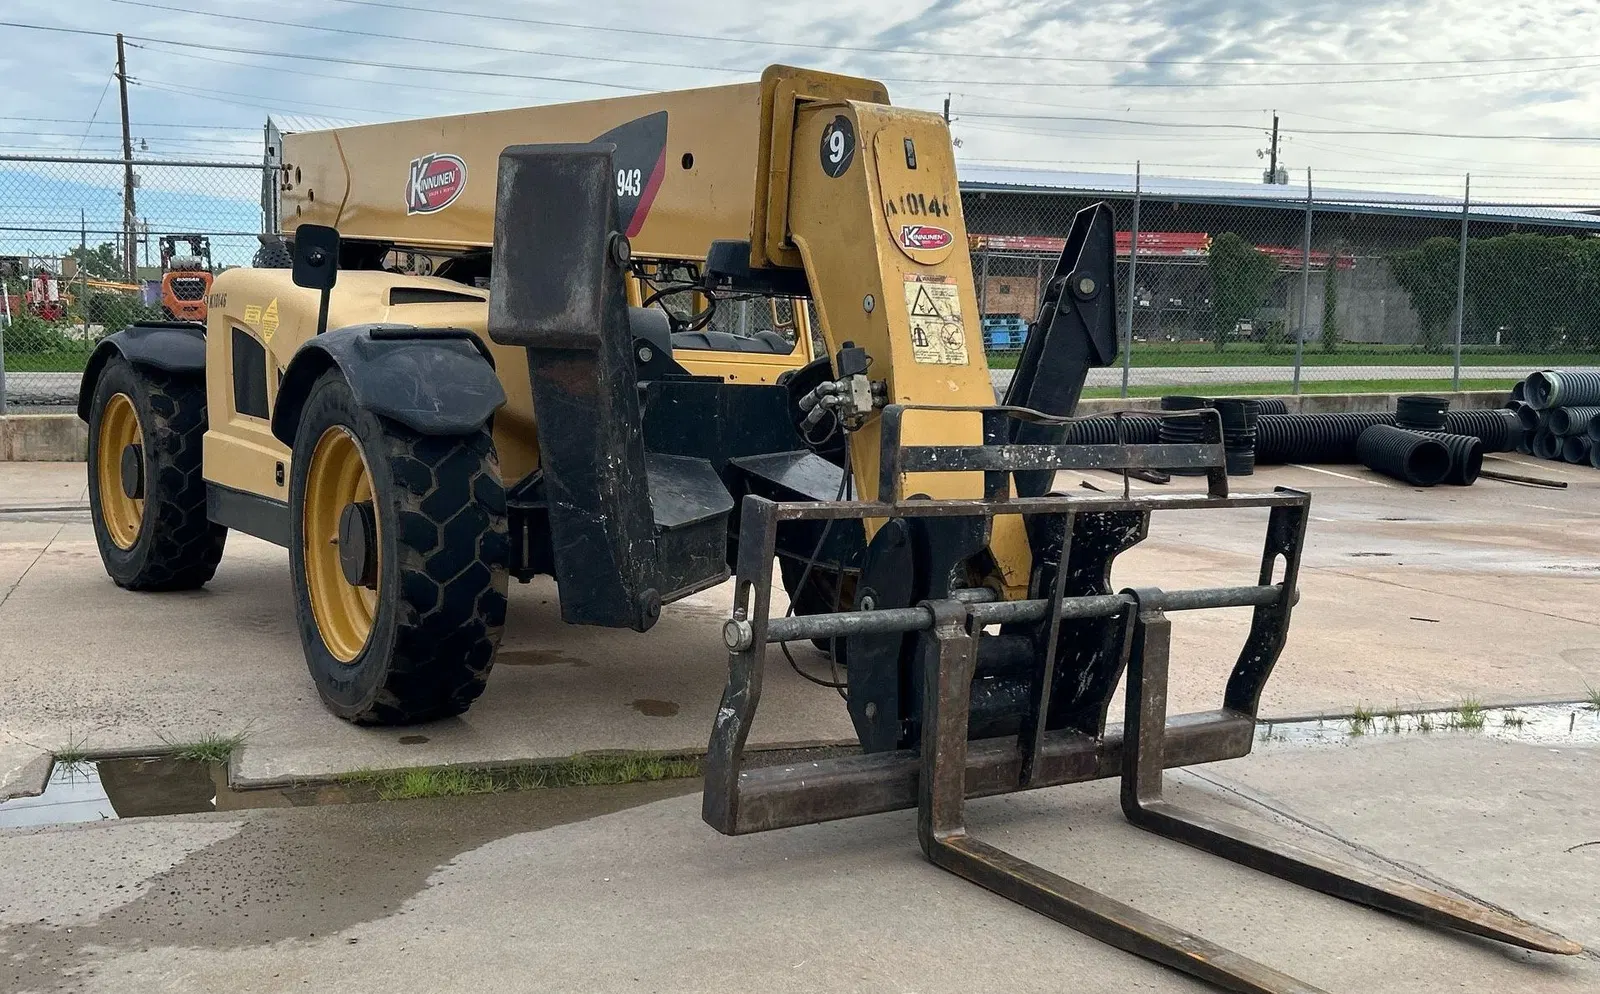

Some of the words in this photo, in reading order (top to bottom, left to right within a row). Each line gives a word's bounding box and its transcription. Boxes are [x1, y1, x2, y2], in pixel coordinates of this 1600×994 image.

[829, 130, 845, 163] 9
[409, 158, 456, 210] KINNUNEN
[616, 168, 641, 197] 943
[904, 227, 943, 247] KINNUNEN
